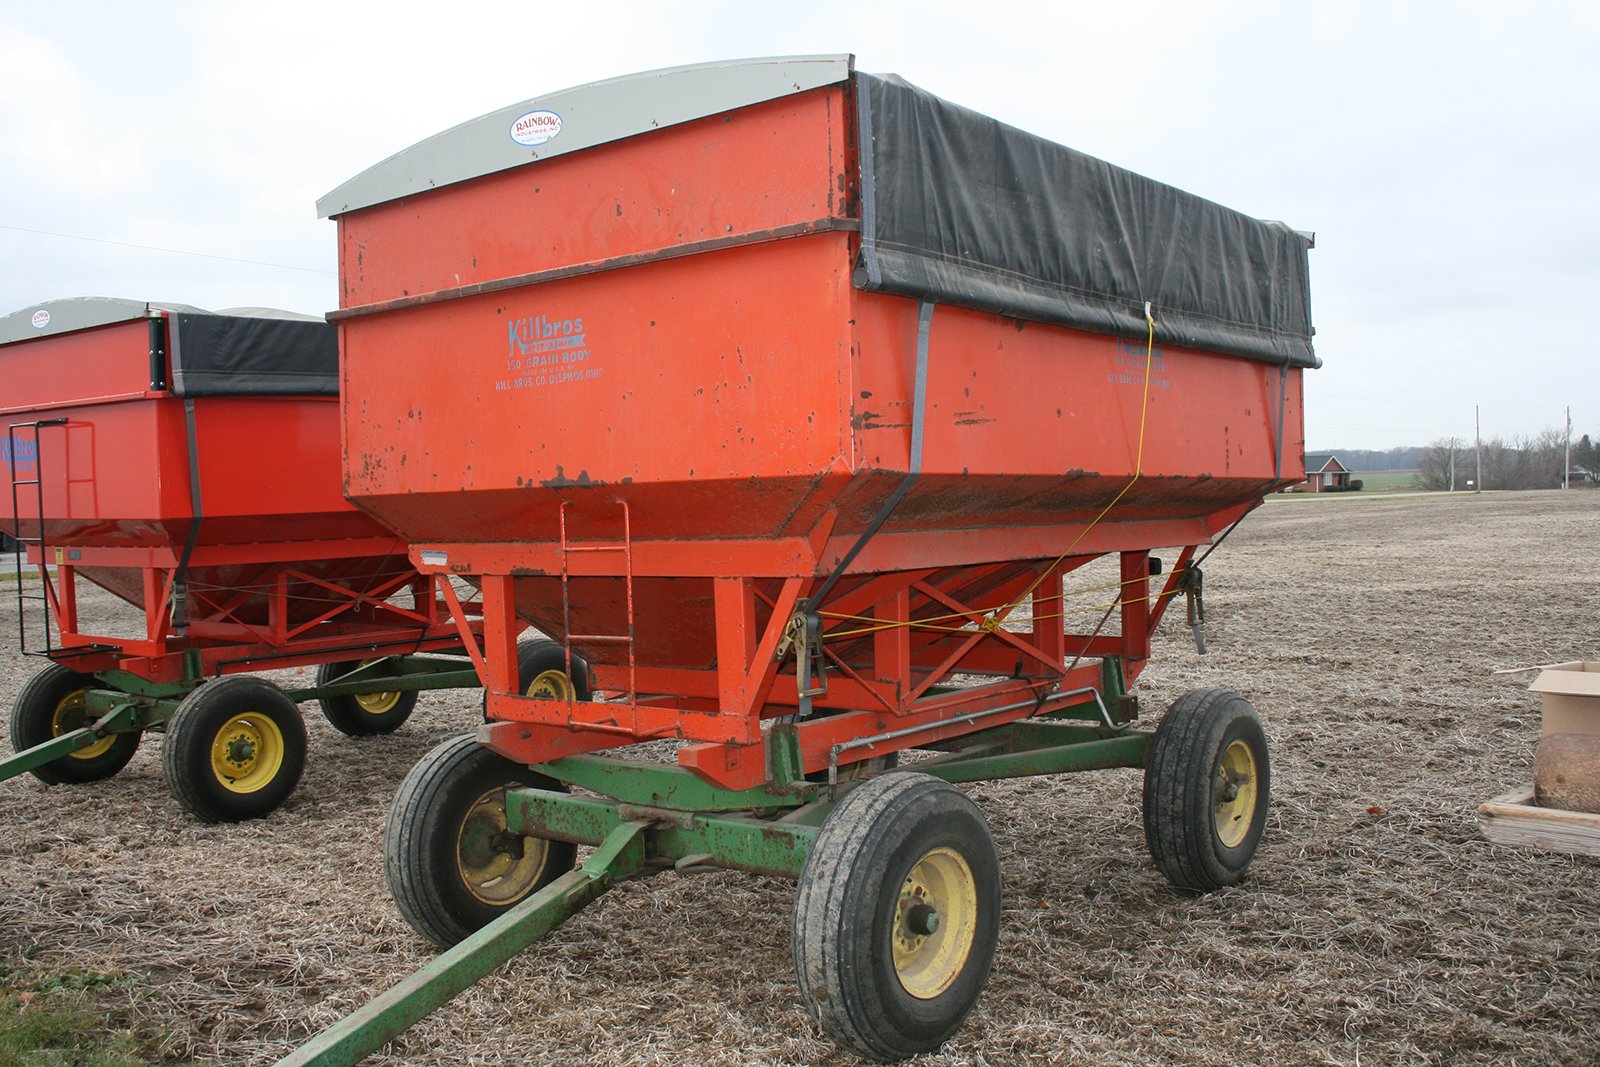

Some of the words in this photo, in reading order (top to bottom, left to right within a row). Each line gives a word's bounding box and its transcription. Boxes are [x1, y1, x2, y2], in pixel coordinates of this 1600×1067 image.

[516, 116, 559, 132] RAINBOW
[508, 315, 584, 357] Killbros
[526, 354, 559, 367] GRAIN
[562, 350, 591, 363] BODY
[495, 380, 511, 390] KILL
